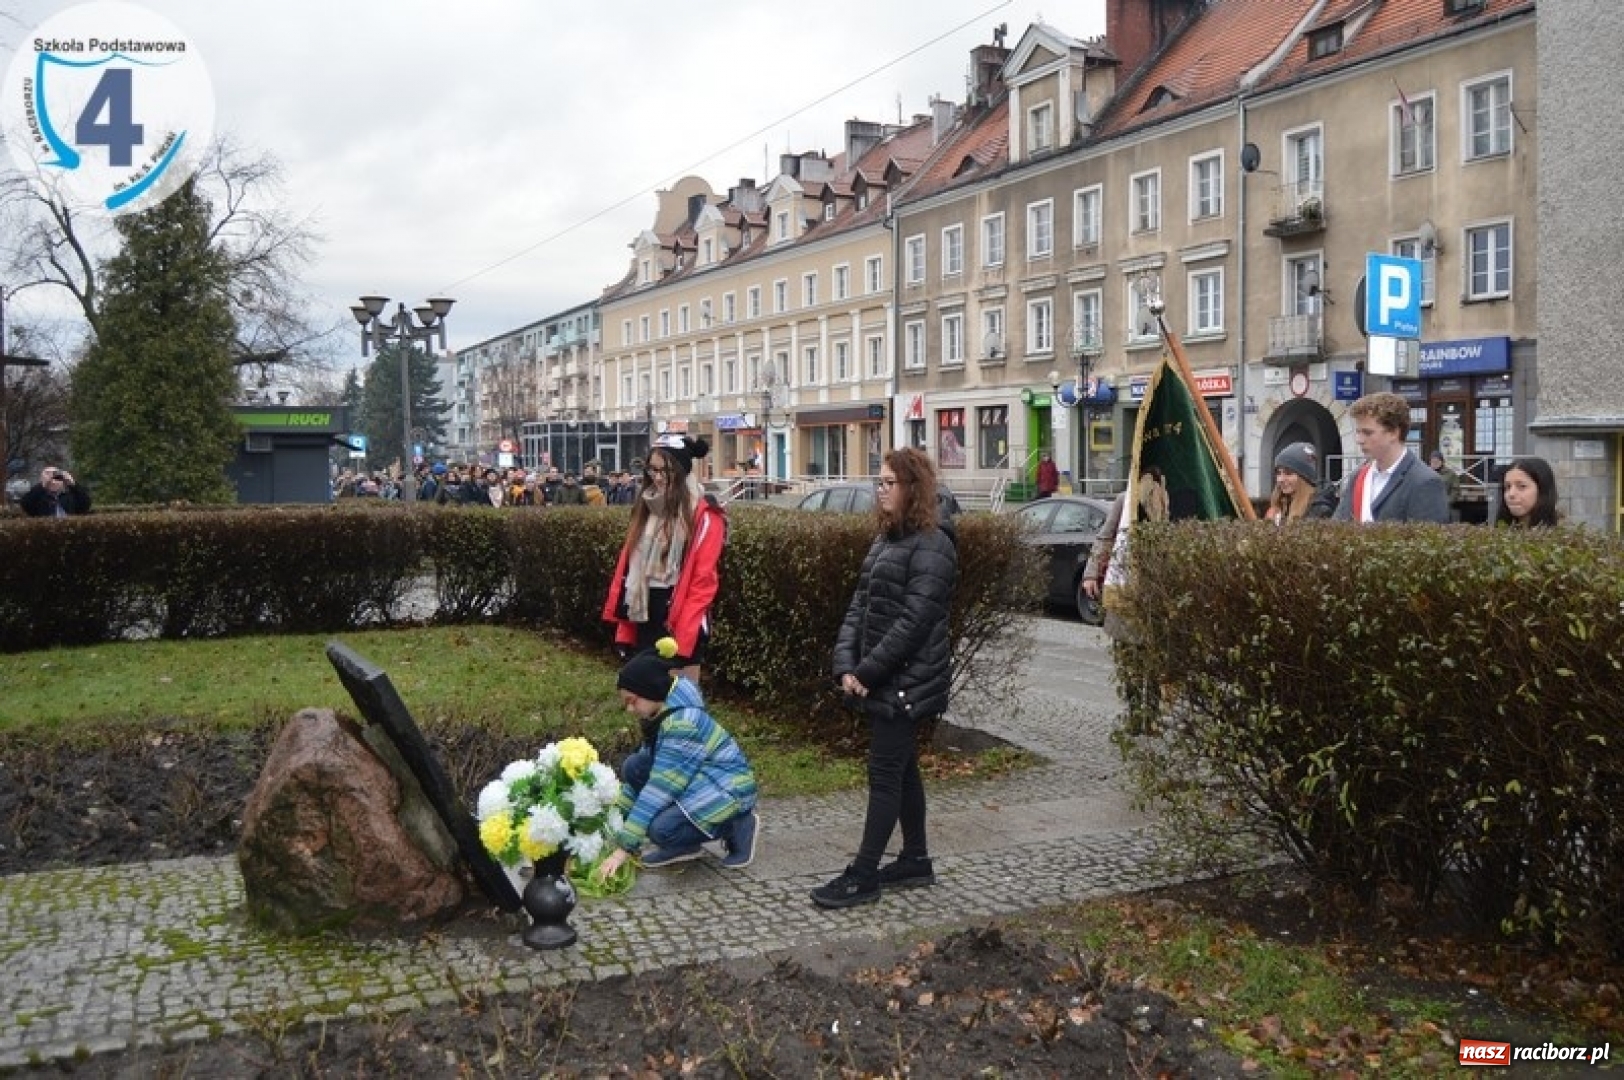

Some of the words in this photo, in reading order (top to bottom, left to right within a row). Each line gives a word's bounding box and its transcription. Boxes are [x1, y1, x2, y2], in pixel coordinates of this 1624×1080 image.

[1380, 263, 1410, 325] P
[1419, 344, 1482, 361] RAINBOW
[290, 413, 330, 425] RUCH
